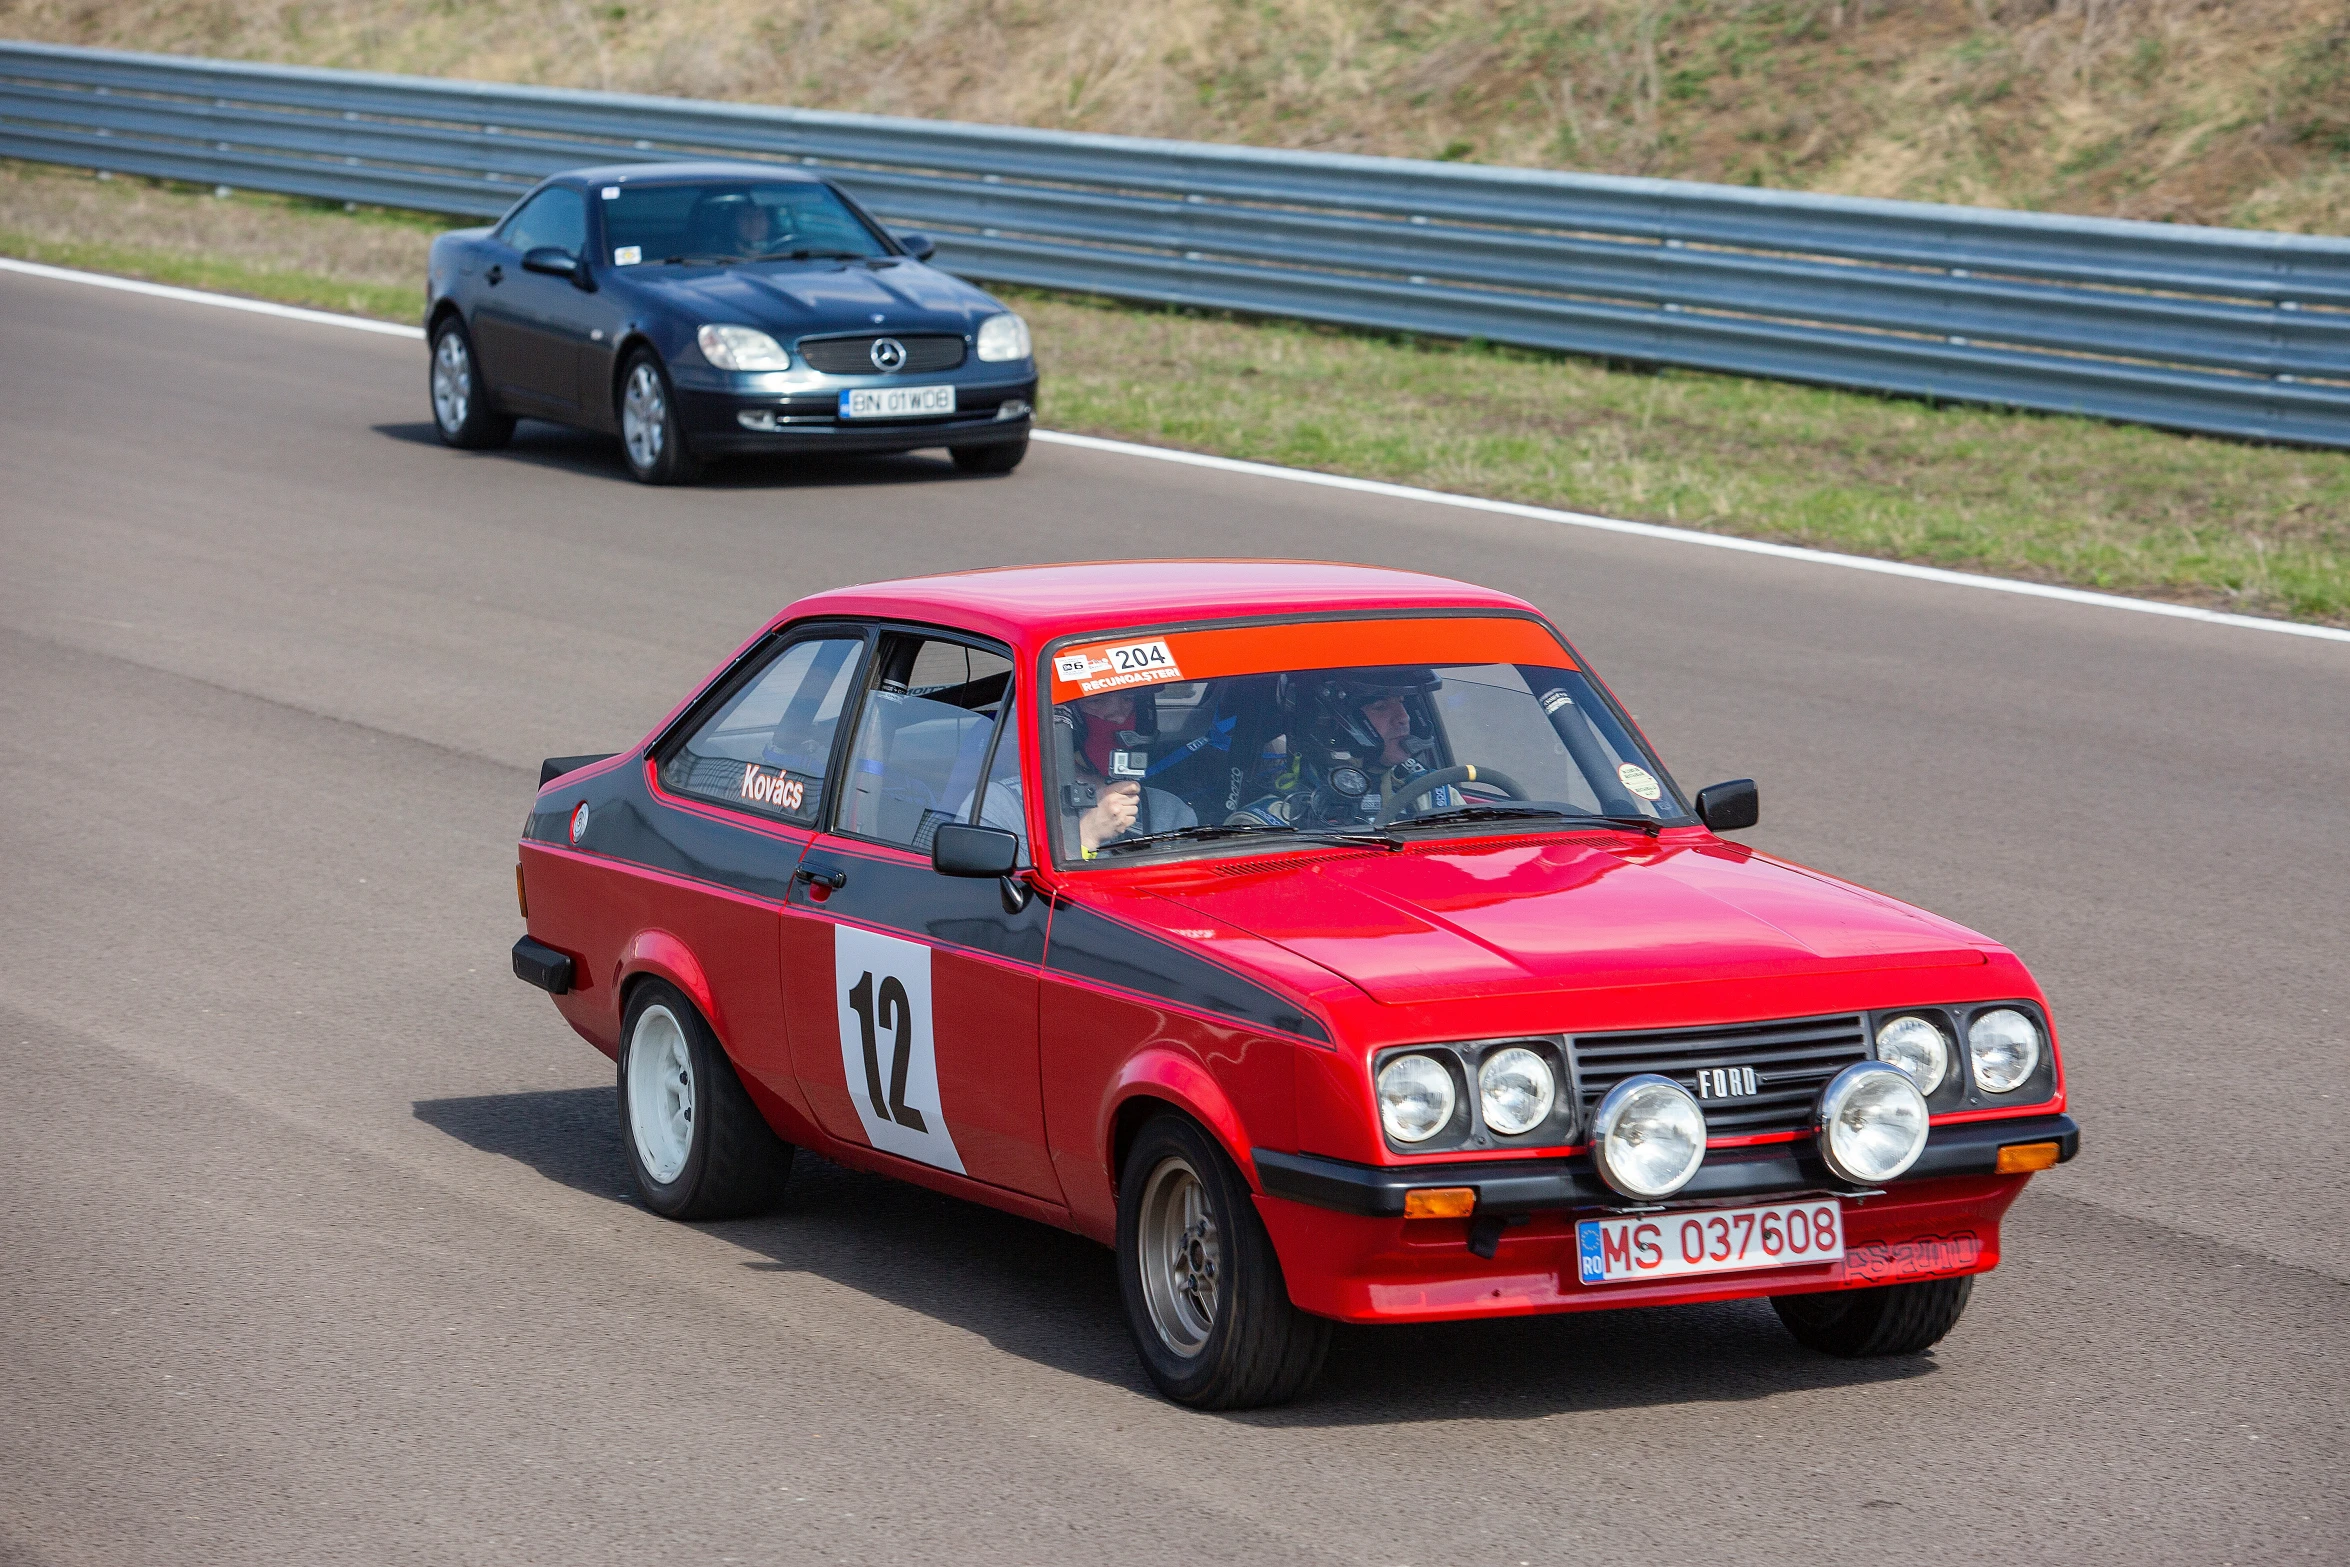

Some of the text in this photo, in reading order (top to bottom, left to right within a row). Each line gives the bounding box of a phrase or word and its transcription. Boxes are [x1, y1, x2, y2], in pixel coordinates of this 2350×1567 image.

[853, 395, 880, 411] BN
[1115, 645, 1166, 670] 204
[741, 763, 804, 810] Kovács
[849, 970, 929, 1134] 12
[1698, 1067, 1757, 1099] FORD
[1601, 1207, 1837, 1273] MS 037608
[1583, 1255, 1603, 1275] RO
